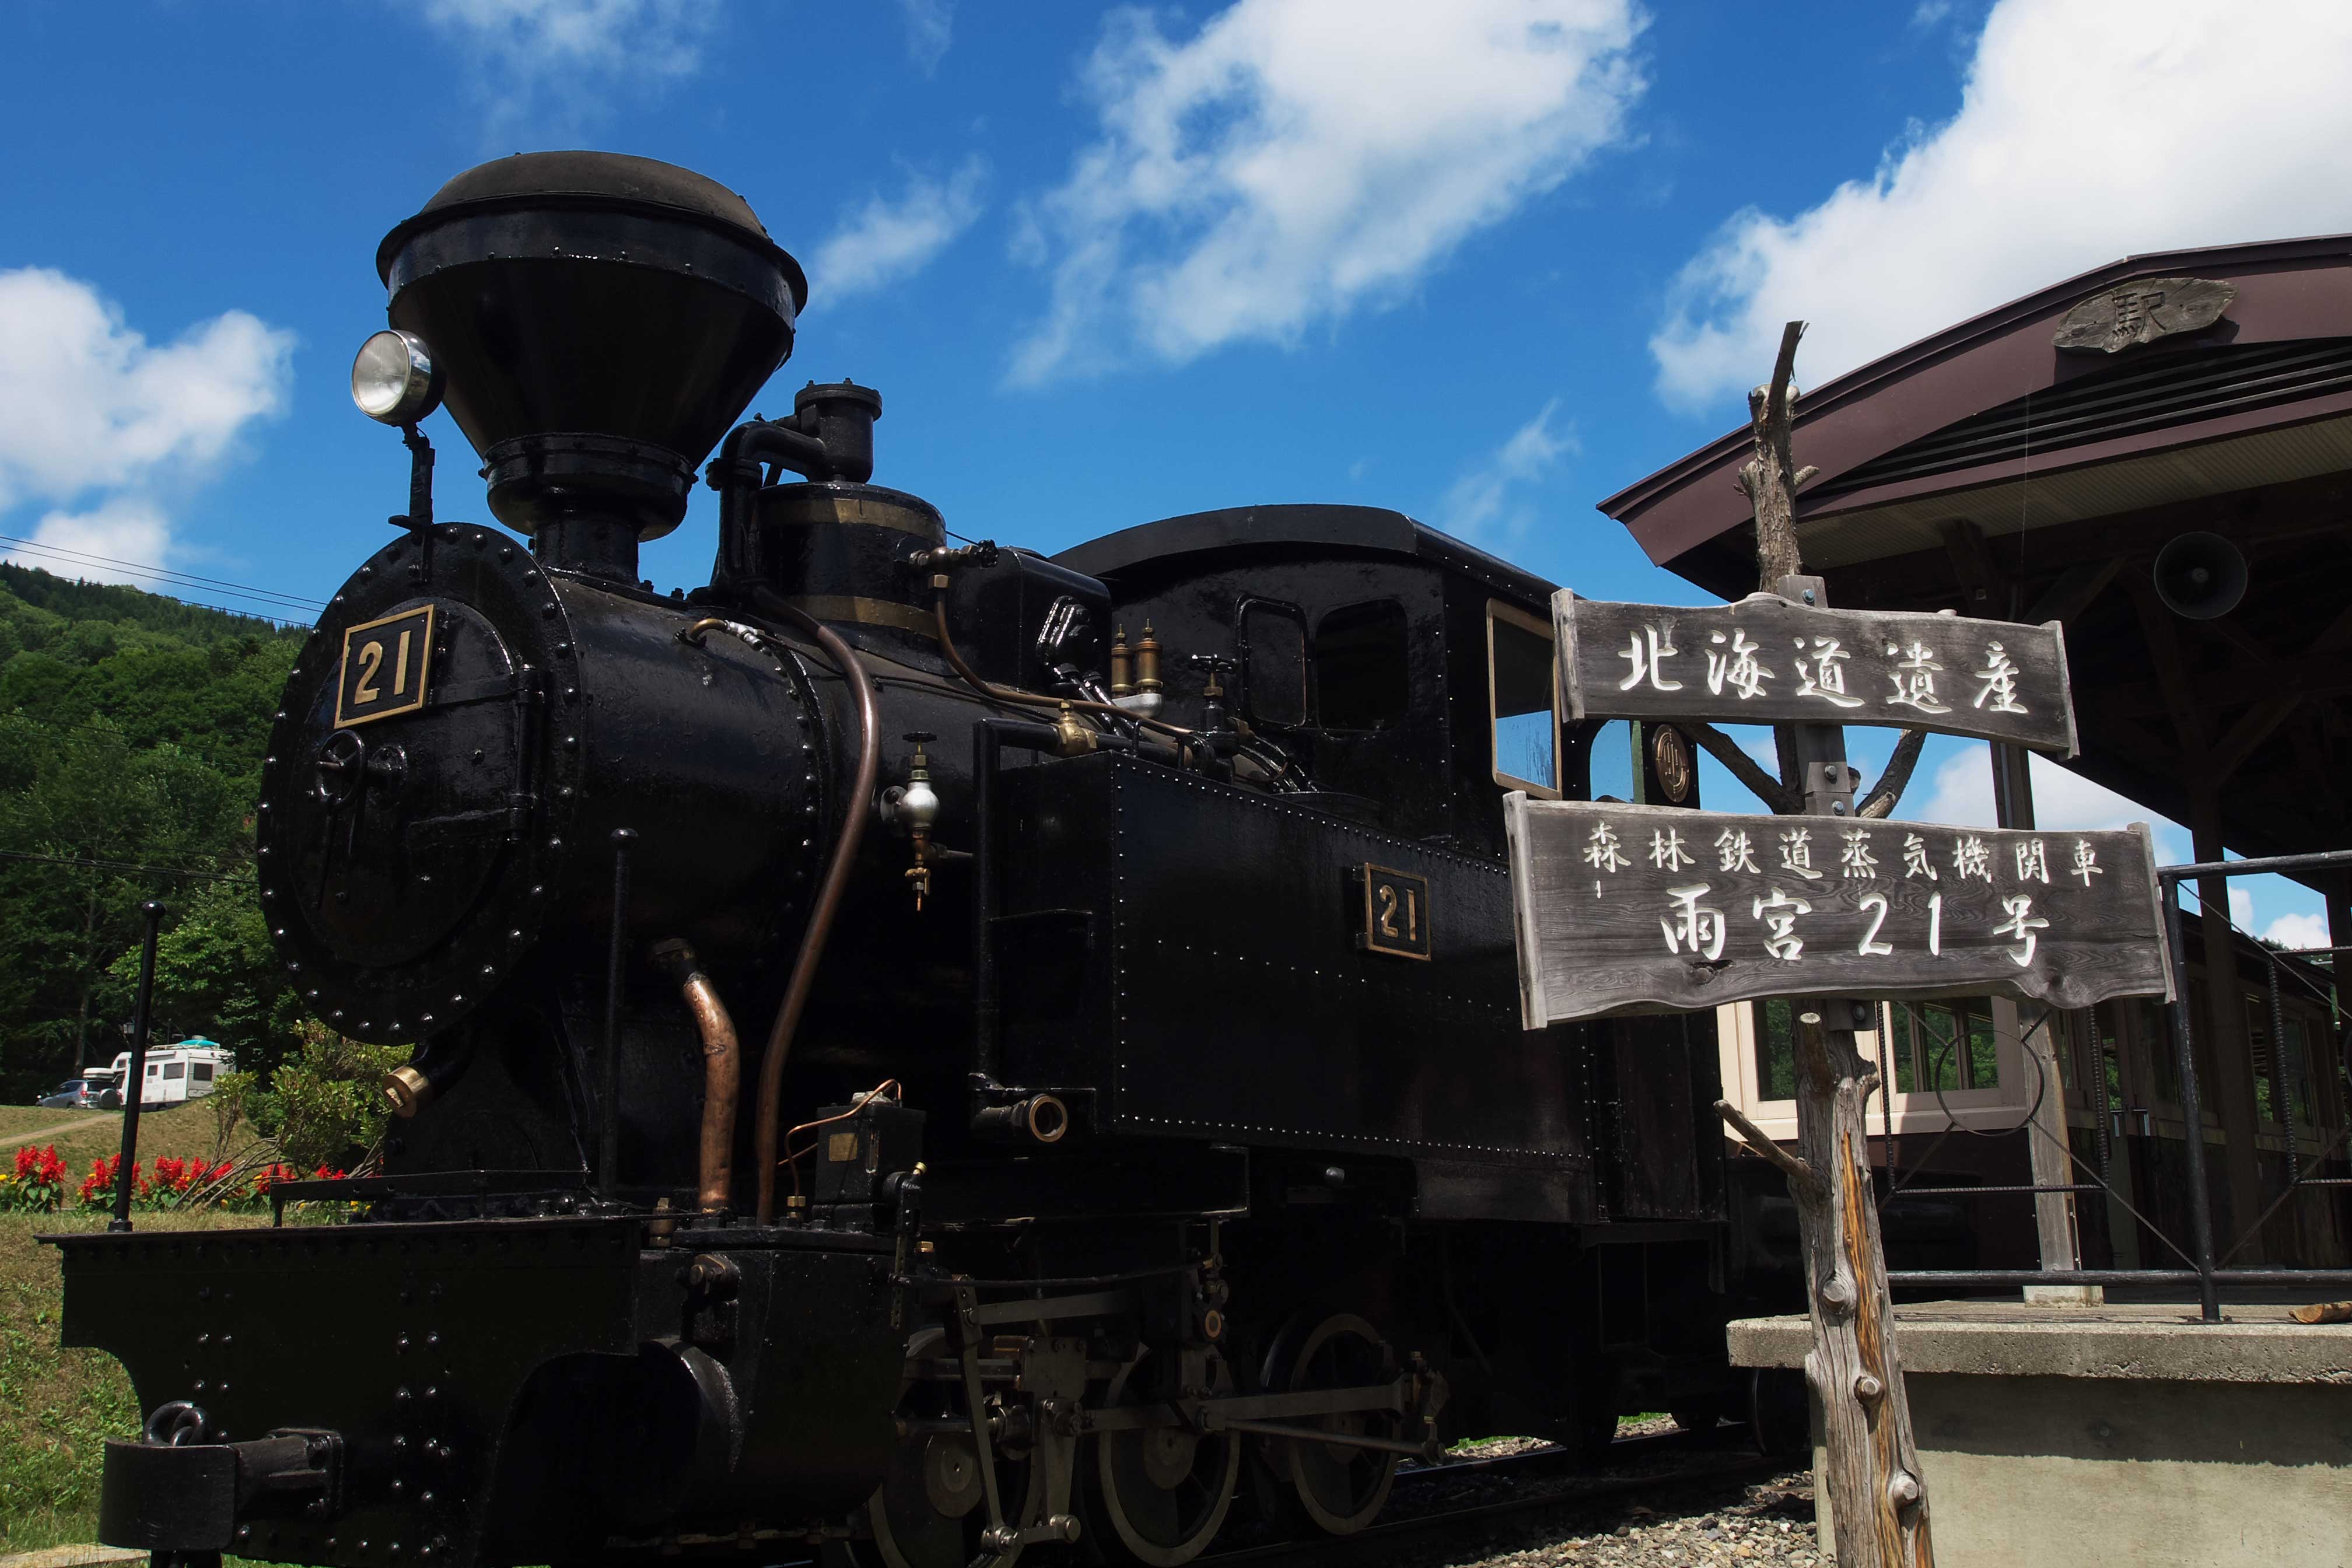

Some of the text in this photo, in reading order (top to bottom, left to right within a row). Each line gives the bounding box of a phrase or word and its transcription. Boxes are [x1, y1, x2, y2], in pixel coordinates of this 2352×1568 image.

[2112, 291, 2166, 338] 駅
[354, 630, 411, 705] 21
[1618, 625, 2029, 715] 北海道遺産
[1583, 819, 2104, 887] 森林鉄道蒸気機関車
[1380, 884, 1416, 942] 21
[1660, 883, 2050, 967] 雨宮21号
